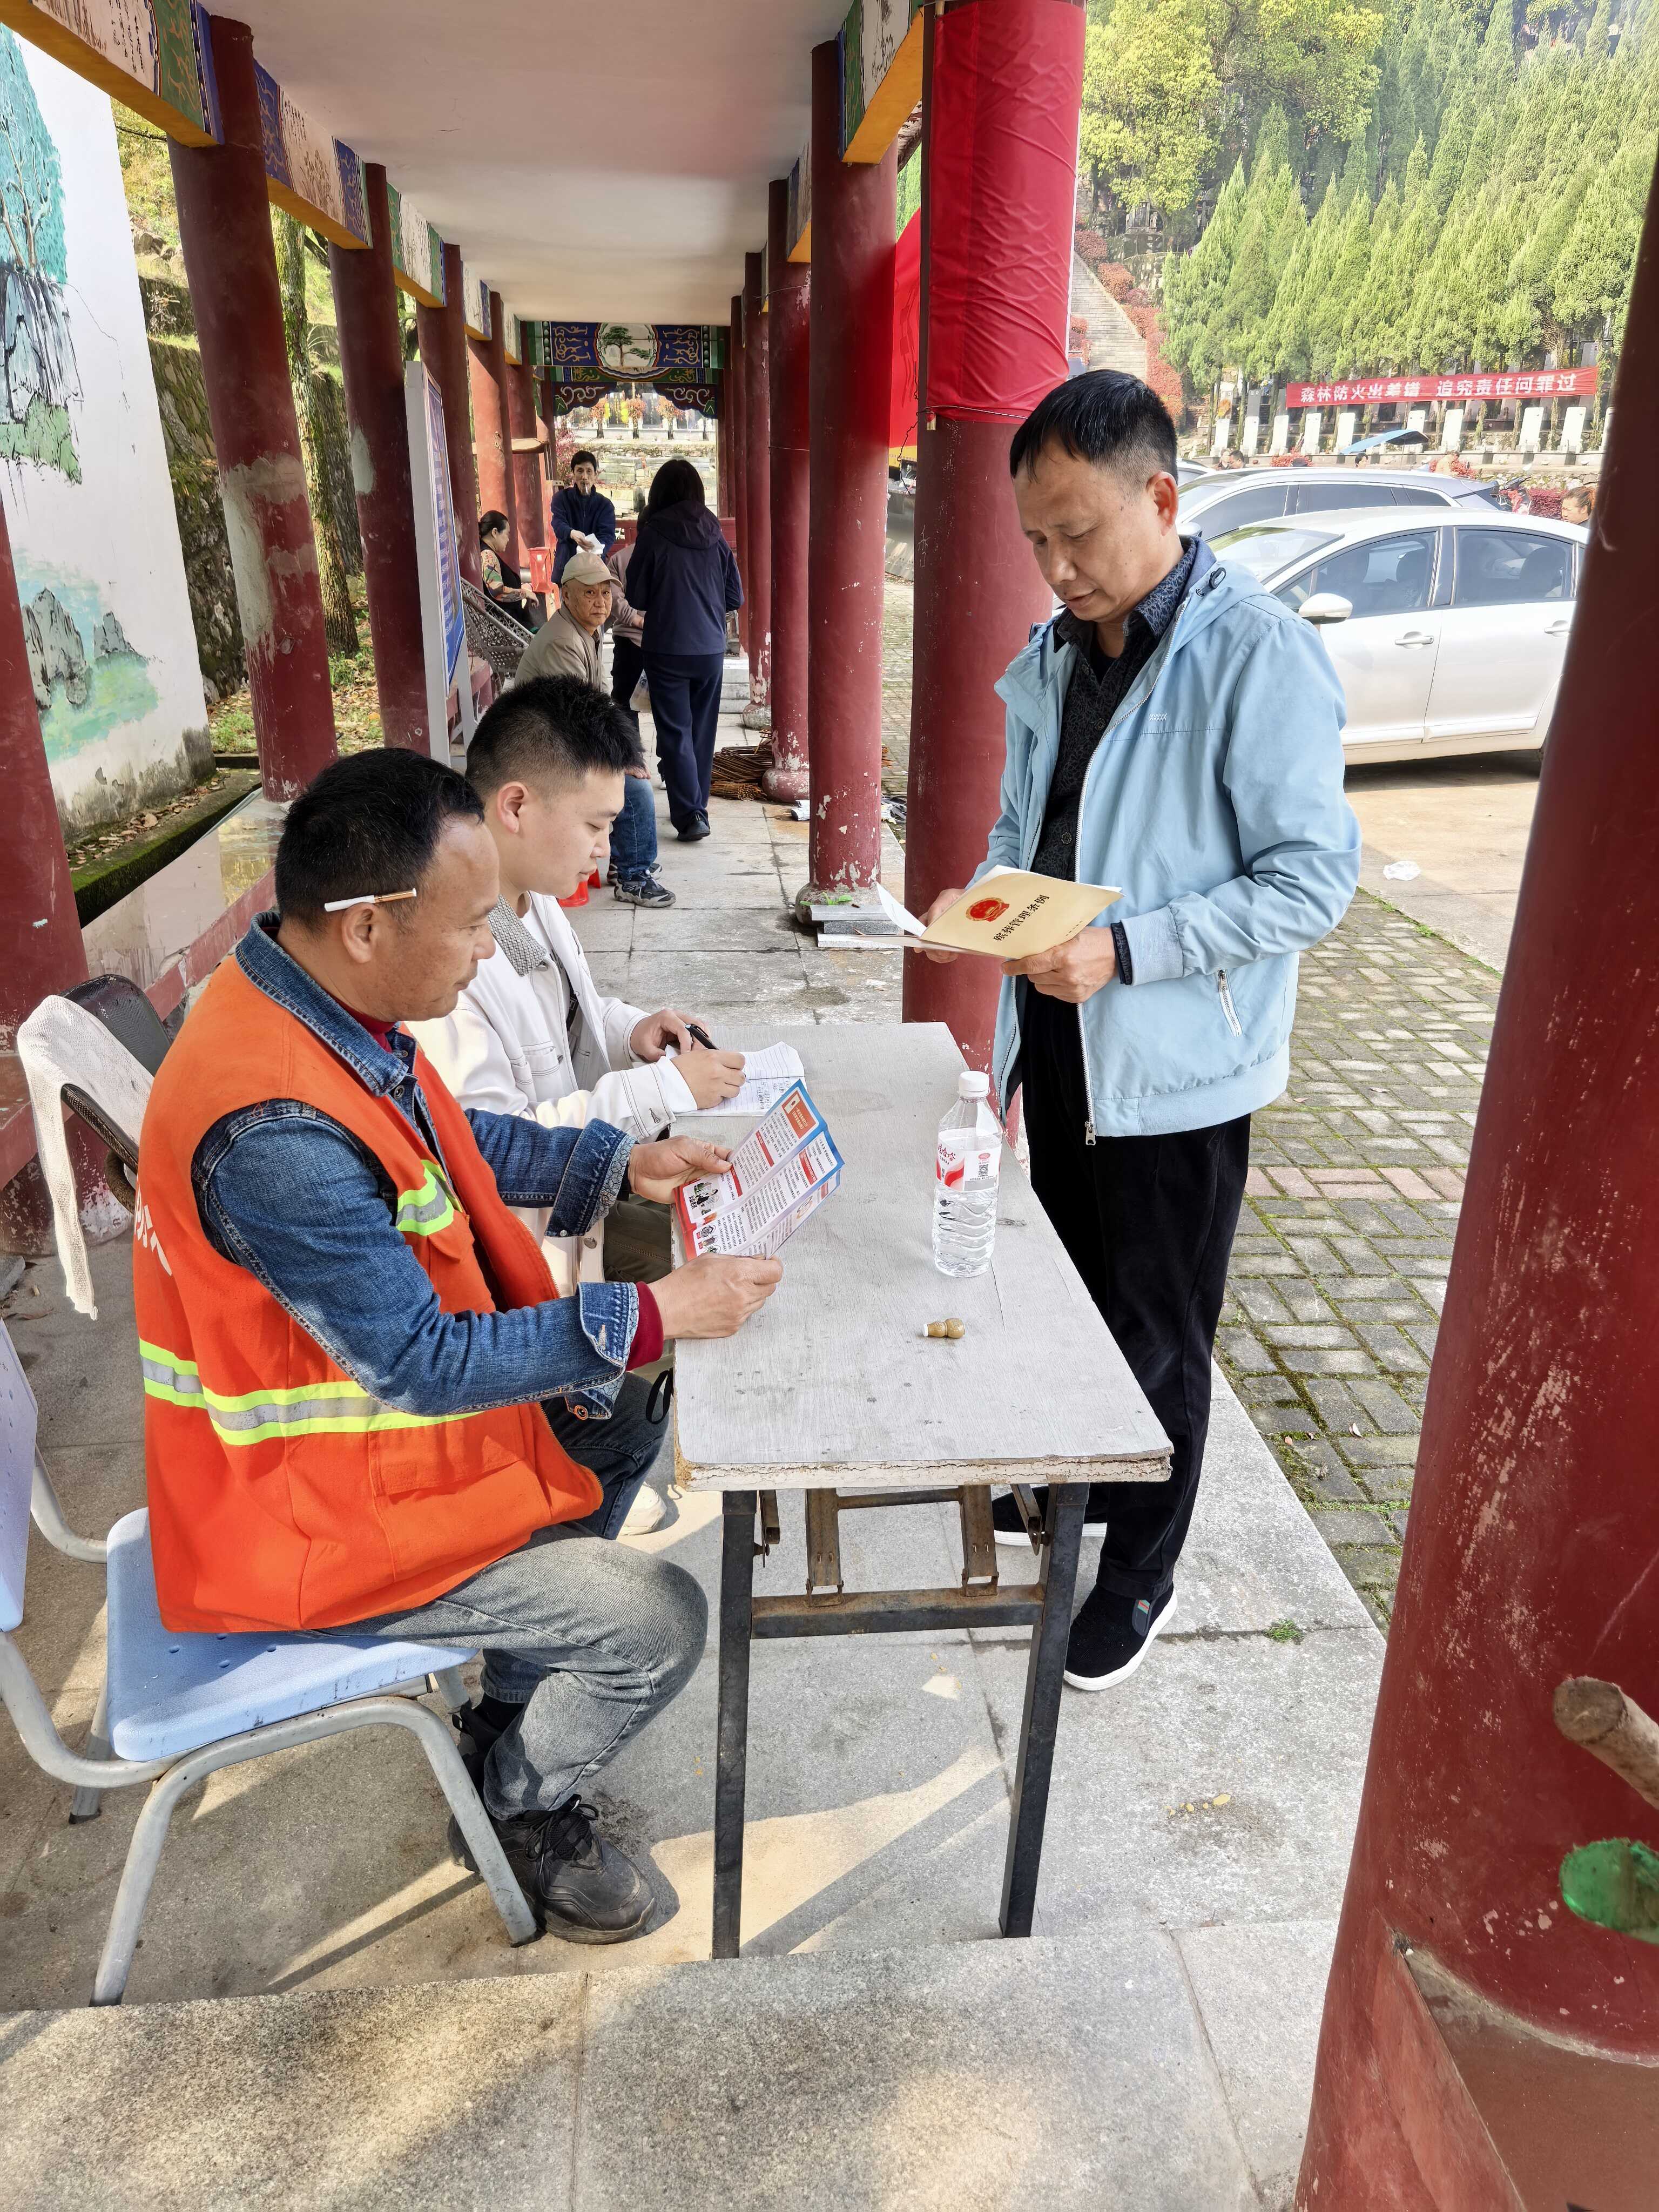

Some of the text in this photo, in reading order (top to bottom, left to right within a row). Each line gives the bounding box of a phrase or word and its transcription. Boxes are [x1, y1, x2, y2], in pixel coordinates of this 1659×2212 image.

[1300, 374, 1577, 403] 森林防火出差错 追究责任问罪过
[993, 894, 1050, 941] 殡葬管理条例
